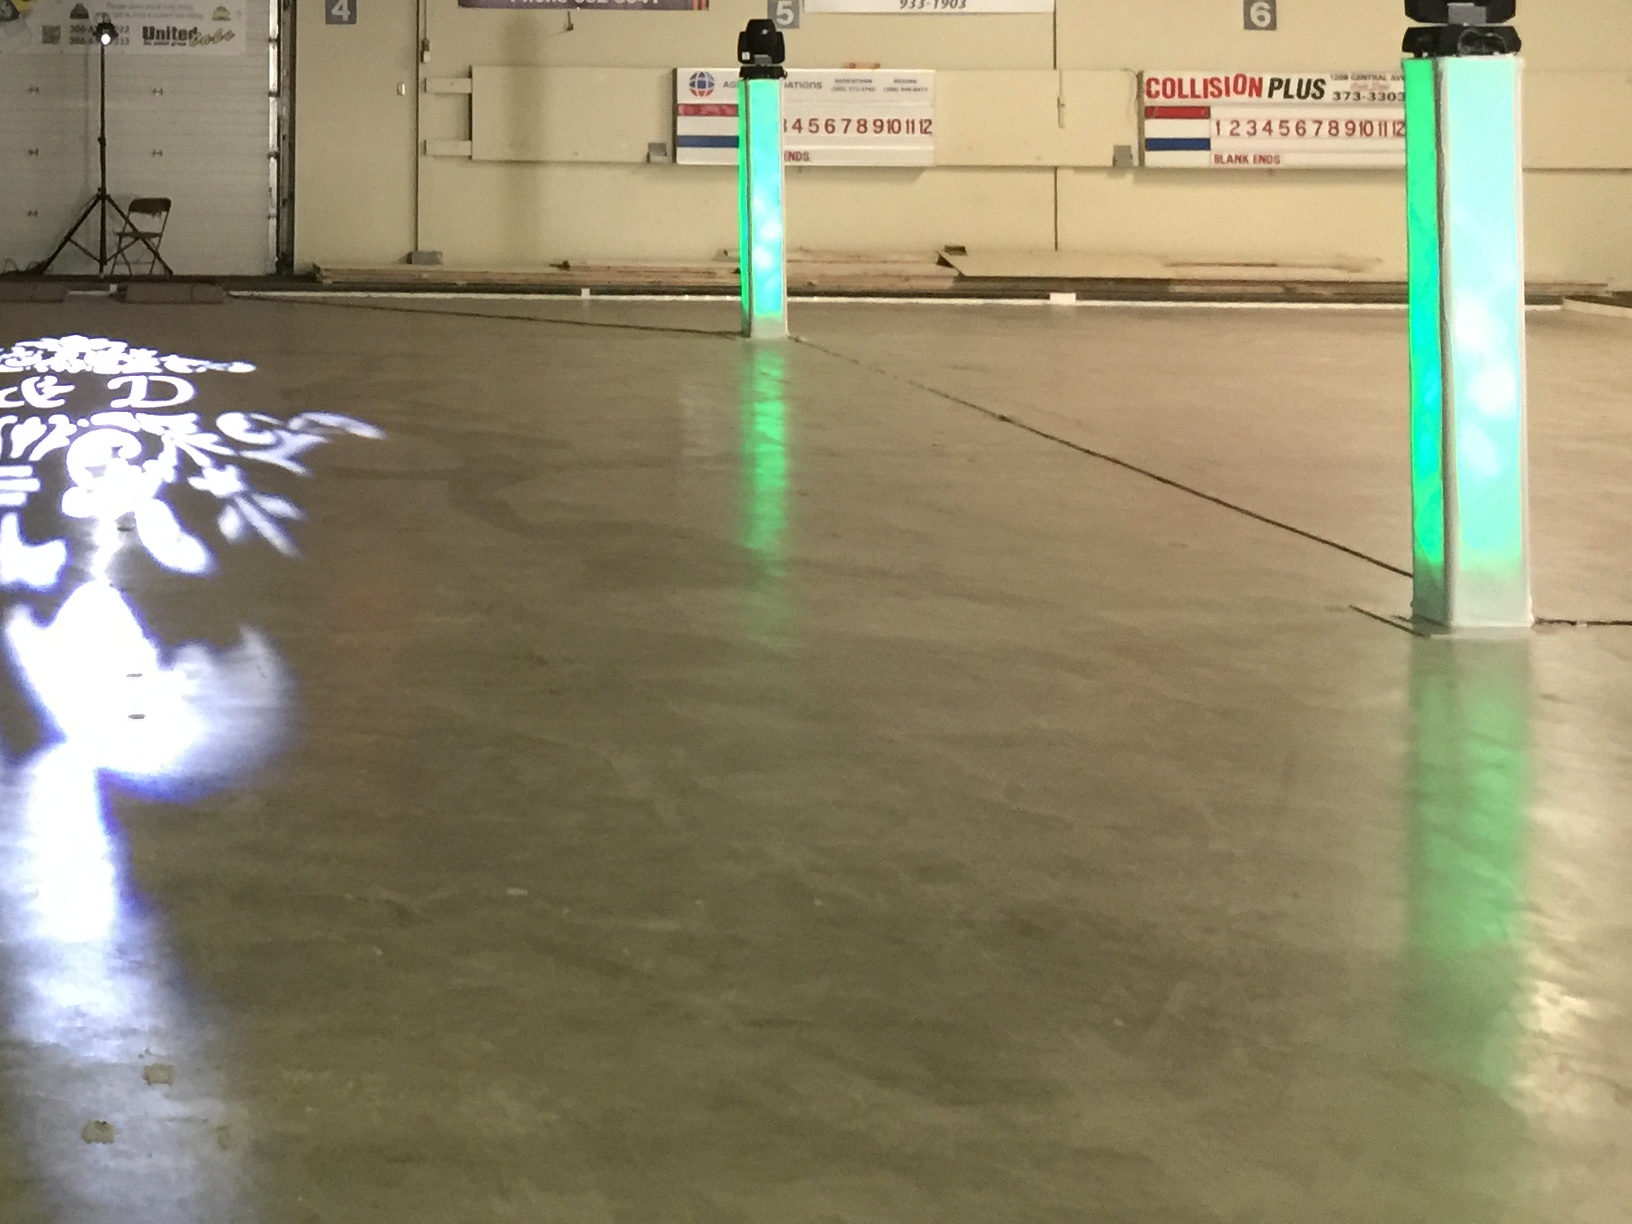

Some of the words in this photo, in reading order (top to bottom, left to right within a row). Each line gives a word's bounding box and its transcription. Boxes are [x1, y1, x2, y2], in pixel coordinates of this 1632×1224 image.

[775, 0, 795, 26] 5
[1248, 1, 1272, 28] 6
[1145, 73, 1263, 99] COLLISION
[1267, 77, 1327, 100] PLUS
[1332, 91, 1406, 102] 373-3303
[792, 118, 803, 135] 4
[808, 118, 819, 135] 5
[823, 118, 835, 135] 6
[840, 118, 852, 135] 7
[856, 118, 868, 135] 8
[872, 118, 884, 135] 9
[886, 118, 902, 135] 10
[905, 118, 915, 135] 11
[919, 118, 932, 135] 12
[1229, 119, 1241, 137] 2
[1246, 119, 1257, 137] 3
[1261, 119, 1274, 137] 4
[1278, 119, 1290, 137] 5
[1295, 119, 1307, 137] 6
[1312, 119, 1323, 137] 7
[1327, 119, 1340, 137] 8
[1344, 119, 1356, 137] 9
[1359, 119, 1374, 137] 10
[1377, 119, 1388, 137] 11
[1391, 119, 1406, 137] 12
[1214, 154, 1249, 165] BLANK
[1252, 154, 1281, 165] ENDS
[106, 374, 195, 409] D
